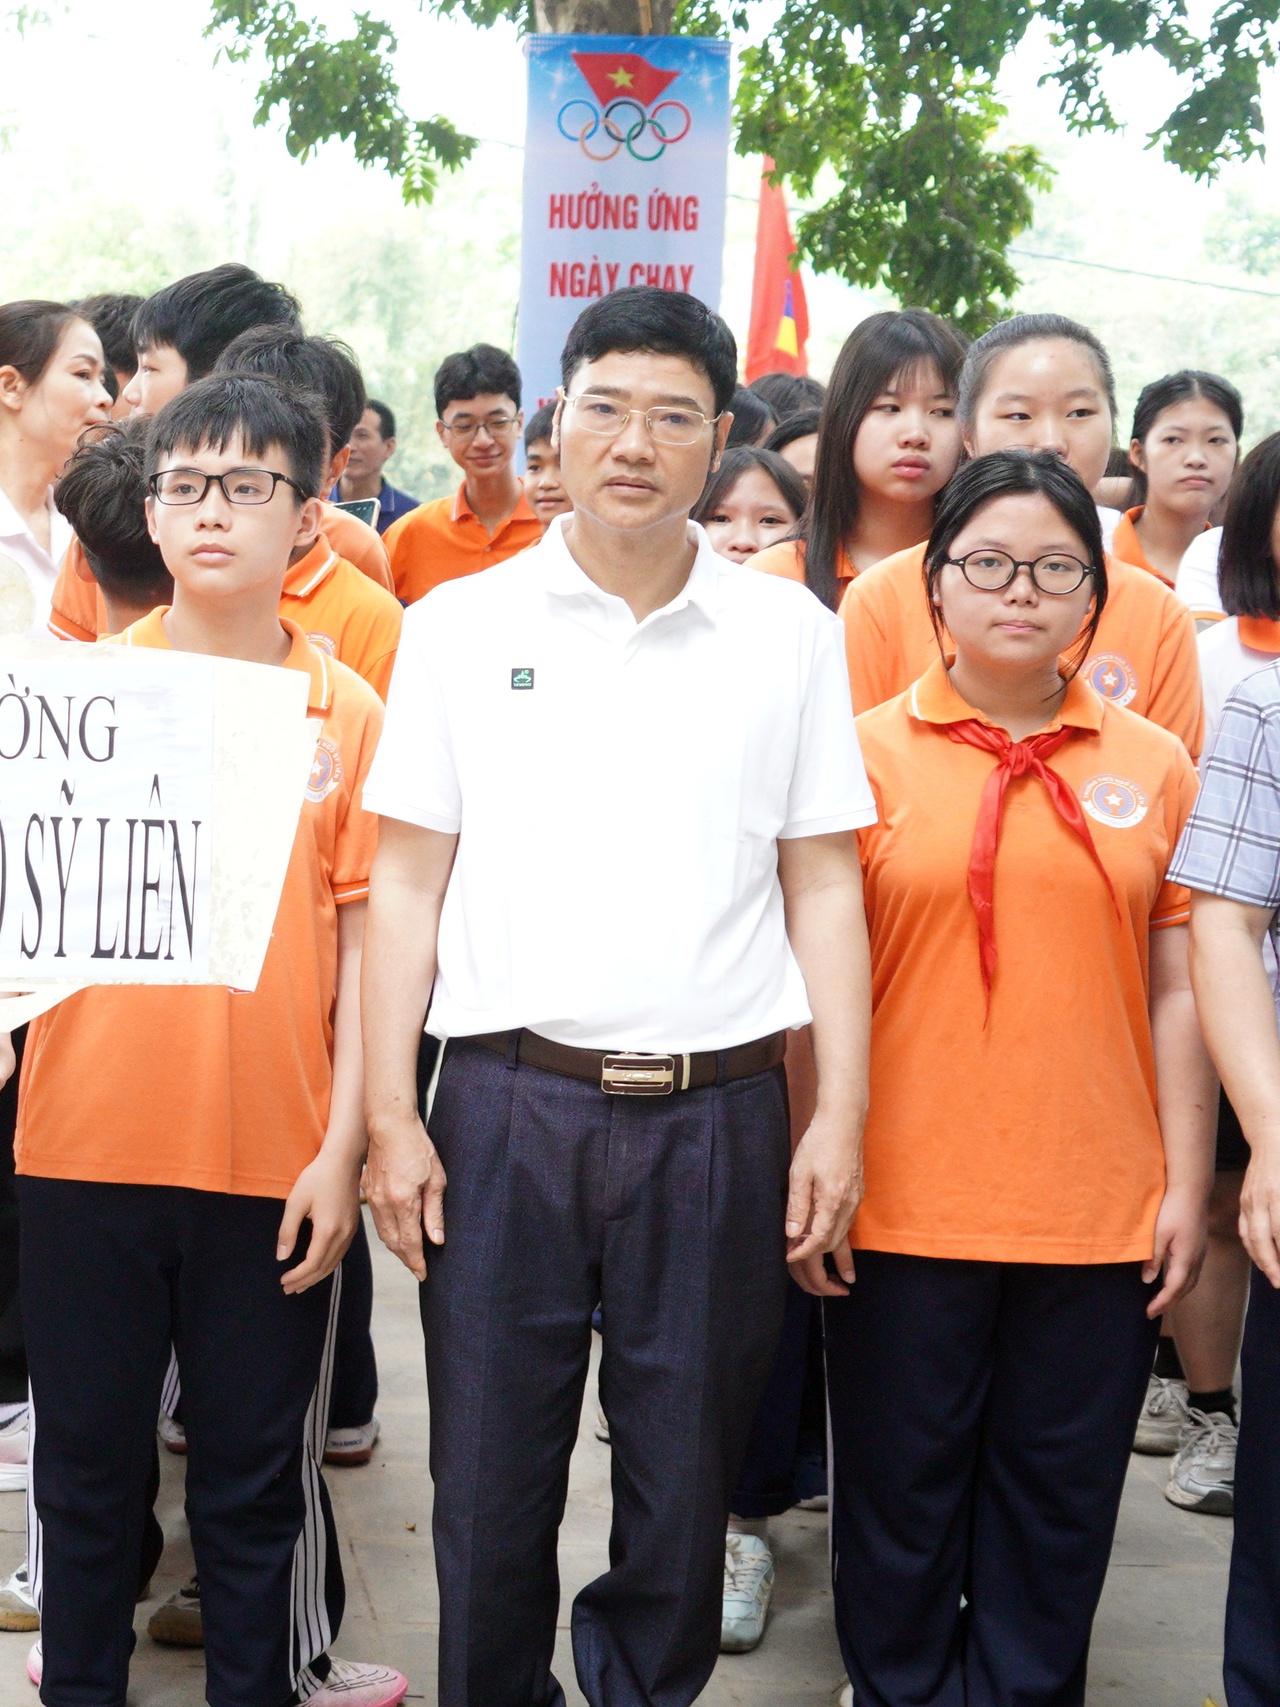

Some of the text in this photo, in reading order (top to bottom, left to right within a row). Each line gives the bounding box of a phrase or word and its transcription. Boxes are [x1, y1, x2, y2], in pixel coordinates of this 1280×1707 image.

[549, 181, 699, 231] HƯỞNG ỨNG
[550, 254, 621, 298] NGÀY
[21, 778, 83, 960] SỸ
[91, 774, 202, 963] LIÊN
